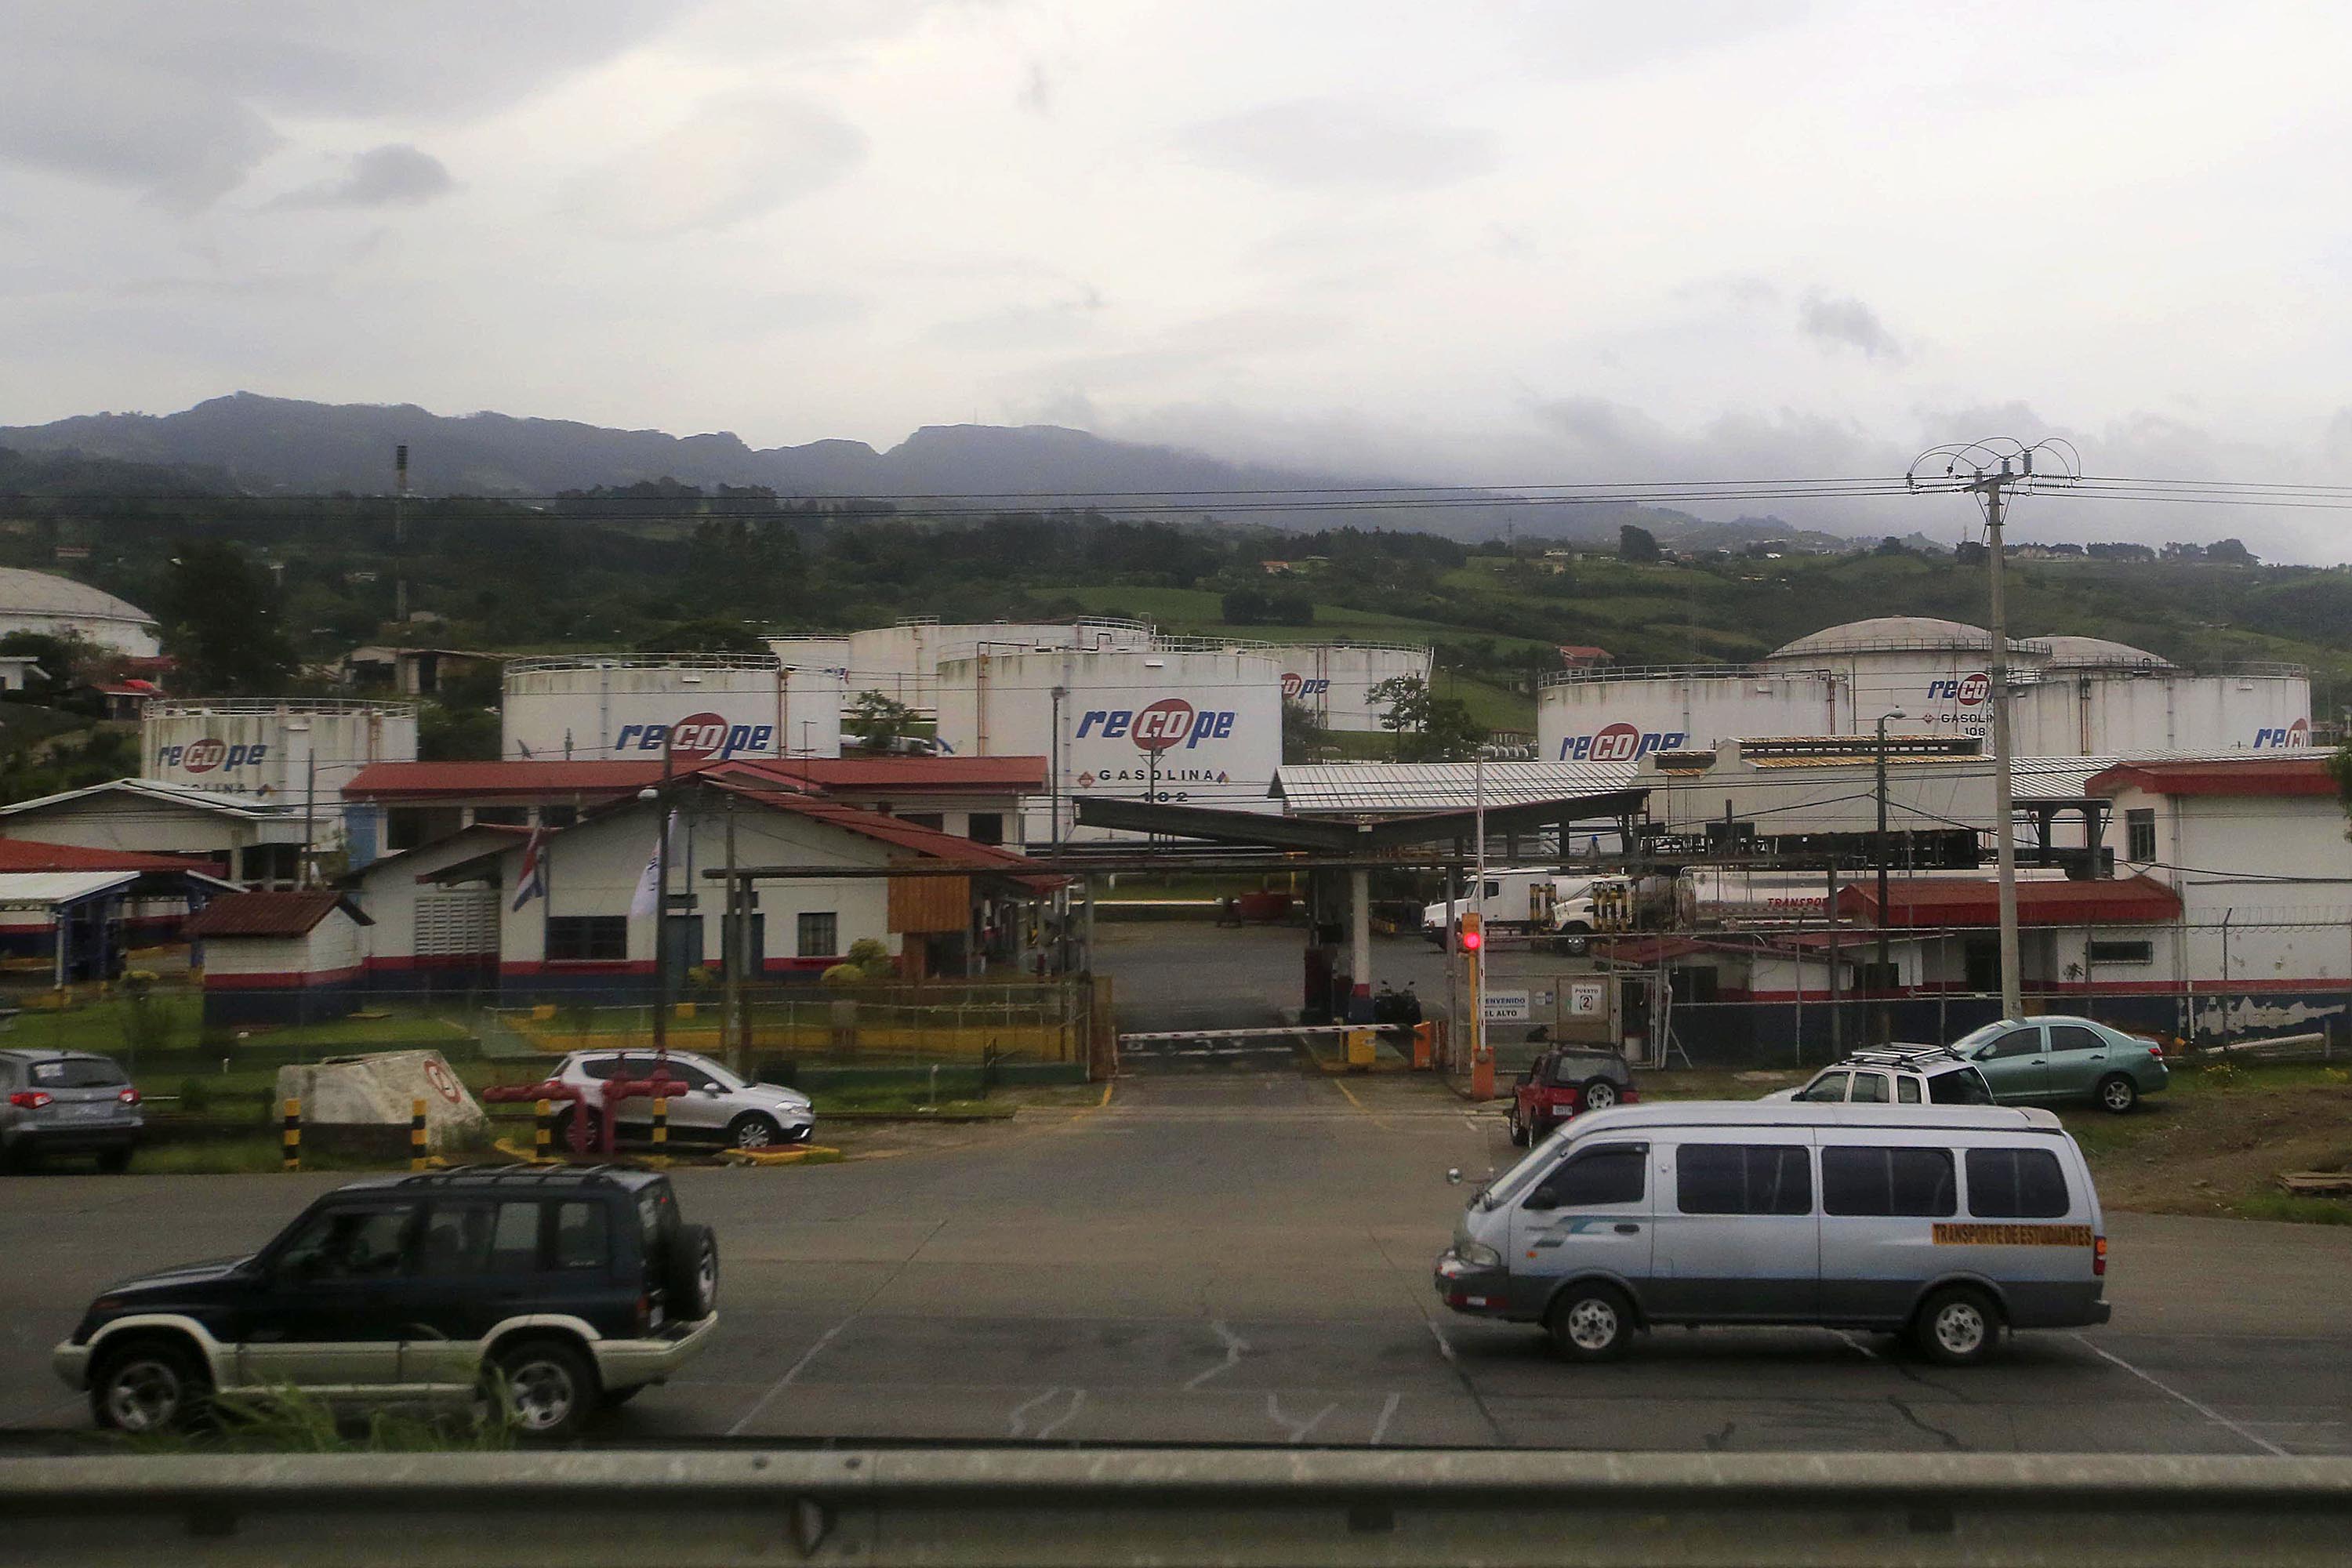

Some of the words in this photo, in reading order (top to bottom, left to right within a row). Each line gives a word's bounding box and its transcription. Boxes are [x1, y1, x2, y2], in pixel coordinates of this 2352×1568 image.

[1280, 679, 1330, 699] ope
[1076, 710, 1236, 750] recope
[1965, 727, 1986, 736] 108
[615, 724, 773, 760] recope
[157, 745, 267, 772] recope
[1099, 770, 1213, 781] GASOLINA
[1767, 897, 1826, 908] TRANSPO
[1583, 996, 1590, 1008] 2
